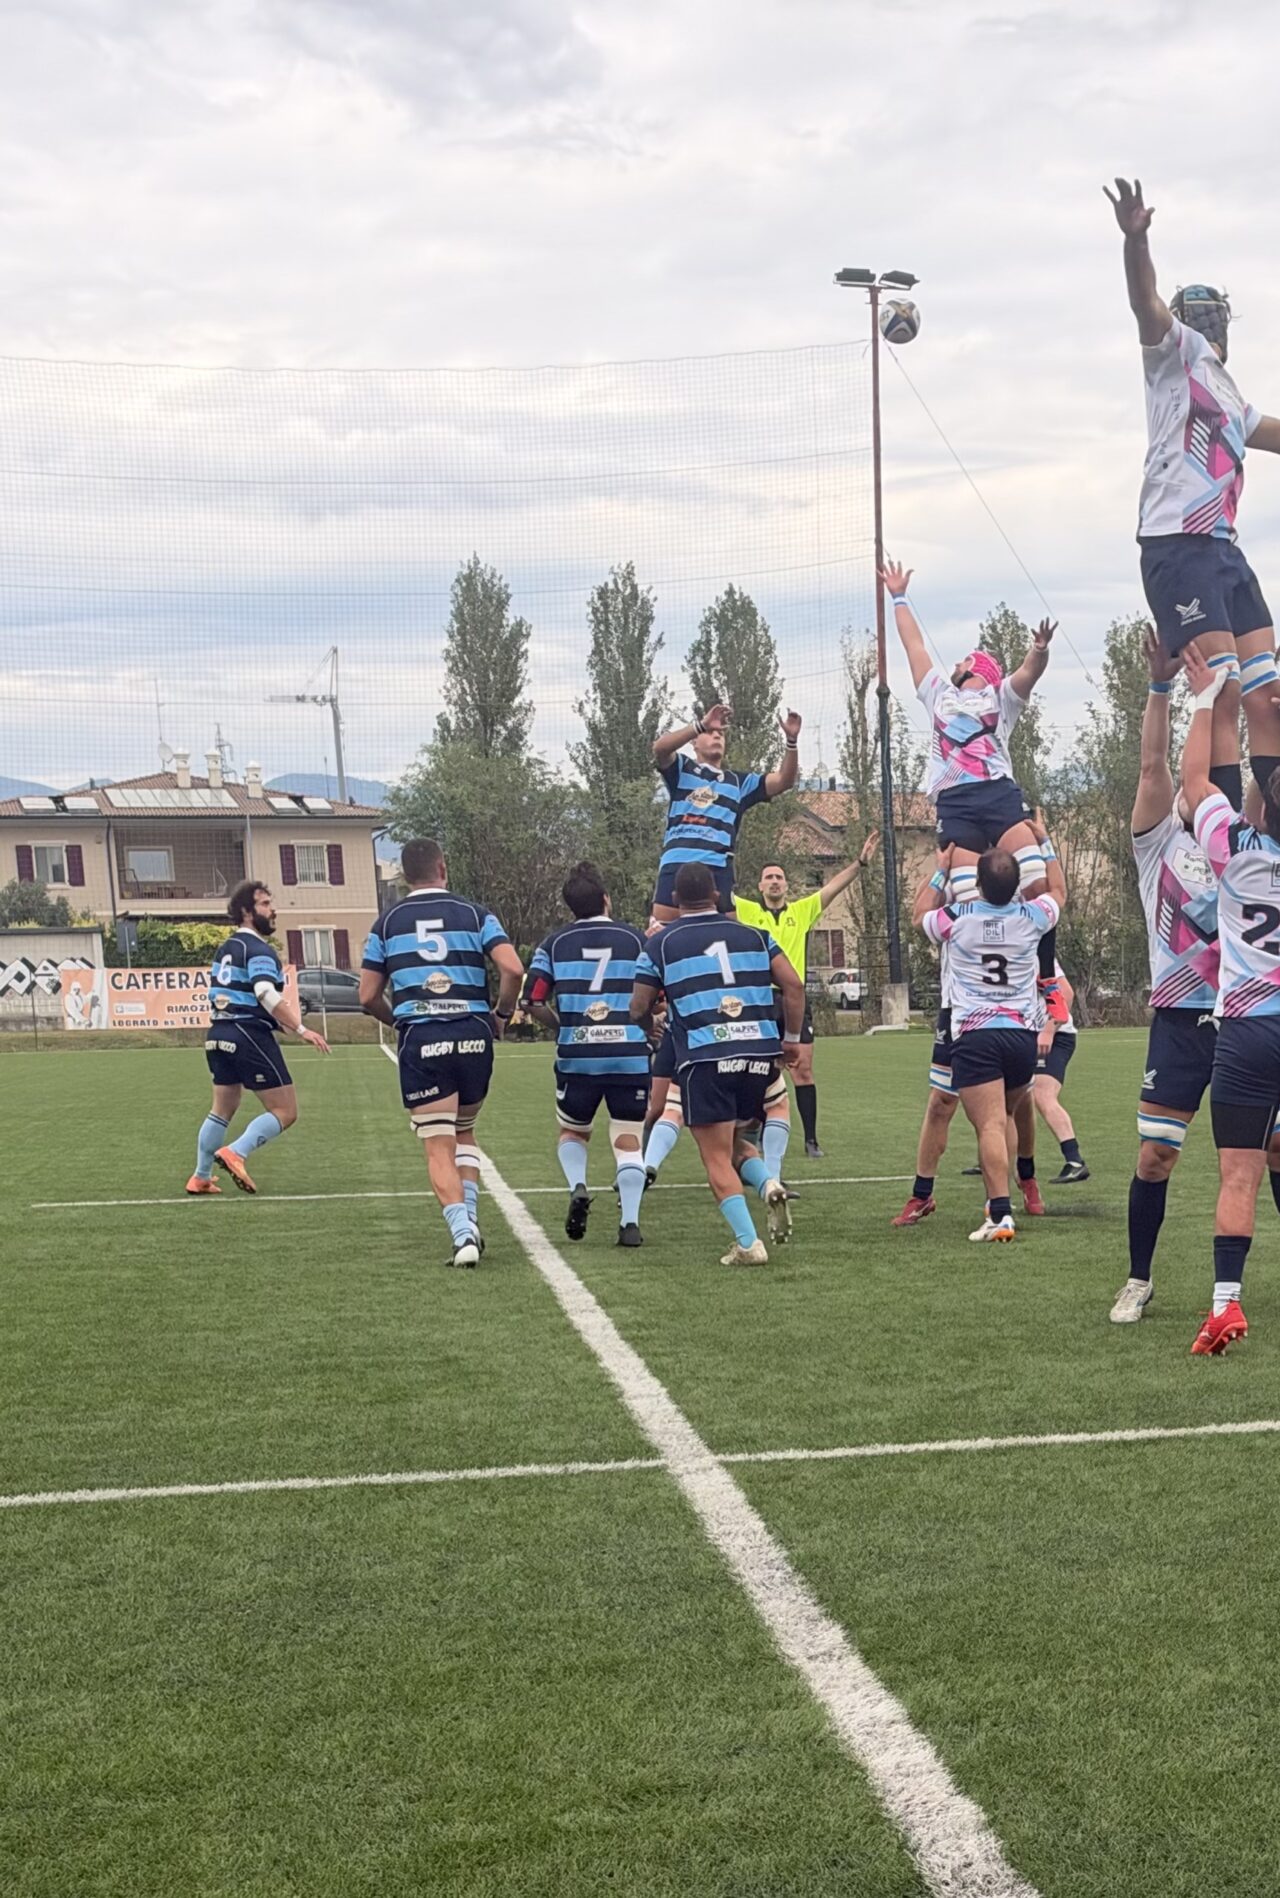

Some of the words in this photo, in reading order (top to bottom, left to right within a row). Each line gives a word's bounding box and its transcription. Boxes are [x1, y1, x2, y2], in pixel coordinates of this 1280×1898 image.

[415, 919, 448, 963] 5
[217, 954, 232, 986] 6
[582, 947, 613, 992] 7
[704, 940, 736, 985] 1
[981, 953, 1009, 986] 3
[113, 1019, 159, 1027] LOGRATO
[181, 1016, 202, 1026] TEL
[167, 1003, 209, 1013] RIMOZI
[421, 1041, 454, 1059] RUGBY
[458, 1039, 486, 1054] LECCO
[717, 1058, 750, 1073] RUGBY
